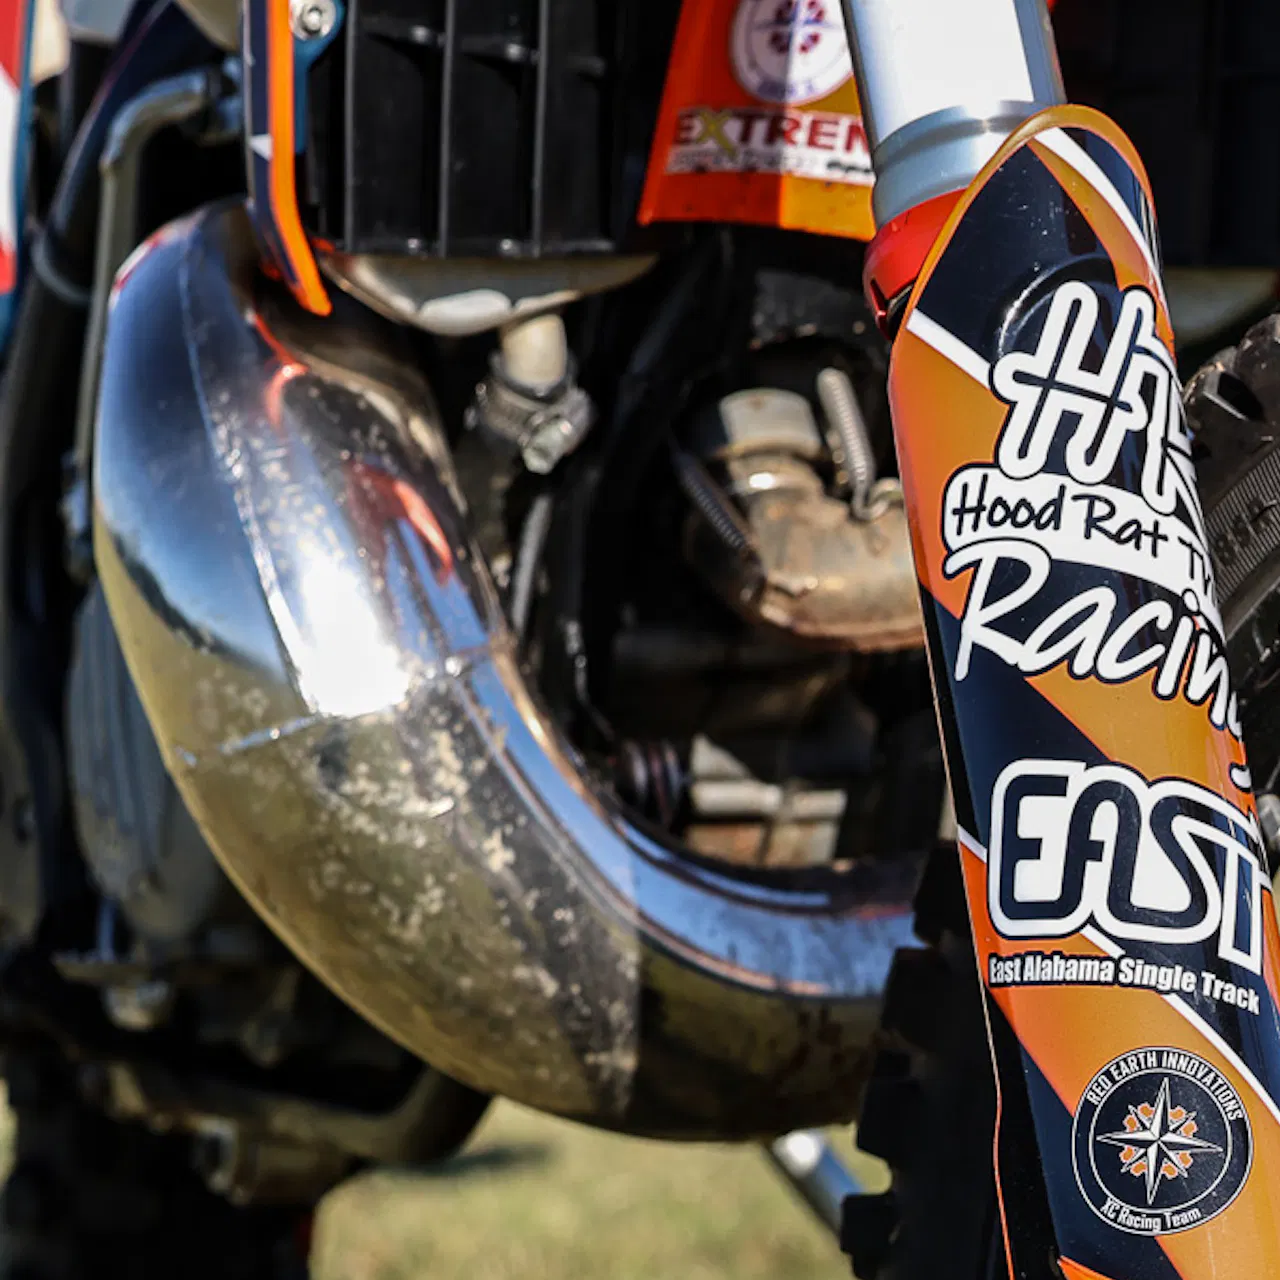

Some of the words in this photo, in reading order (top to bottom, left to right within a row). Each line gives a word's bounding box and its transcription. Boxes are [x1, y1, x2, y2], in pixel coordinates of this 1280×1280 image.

[952, 473, 1067, 536] Hood
[1070, 493, 1169, 559] Rat
[989, 759, 1269, 975] EAST
[988, 956, 1021, 984] East
[1021, 954, 1116, 983] Alabama
[1118, 957, 1196, 993] Single
[1200, 971, 1260, 1016] Track
[1086, 1074, 1113, 1107] RED
[1110, 1051, 1158, 1080] EARTH
[1161, 1051, 1244, 1121] INNOVATIONS
[1100, 1197, 1120, 1219] XC
[1117, 1207, 1162, 1232] Racing
[1164, 1207, 1202, 1229] Team
